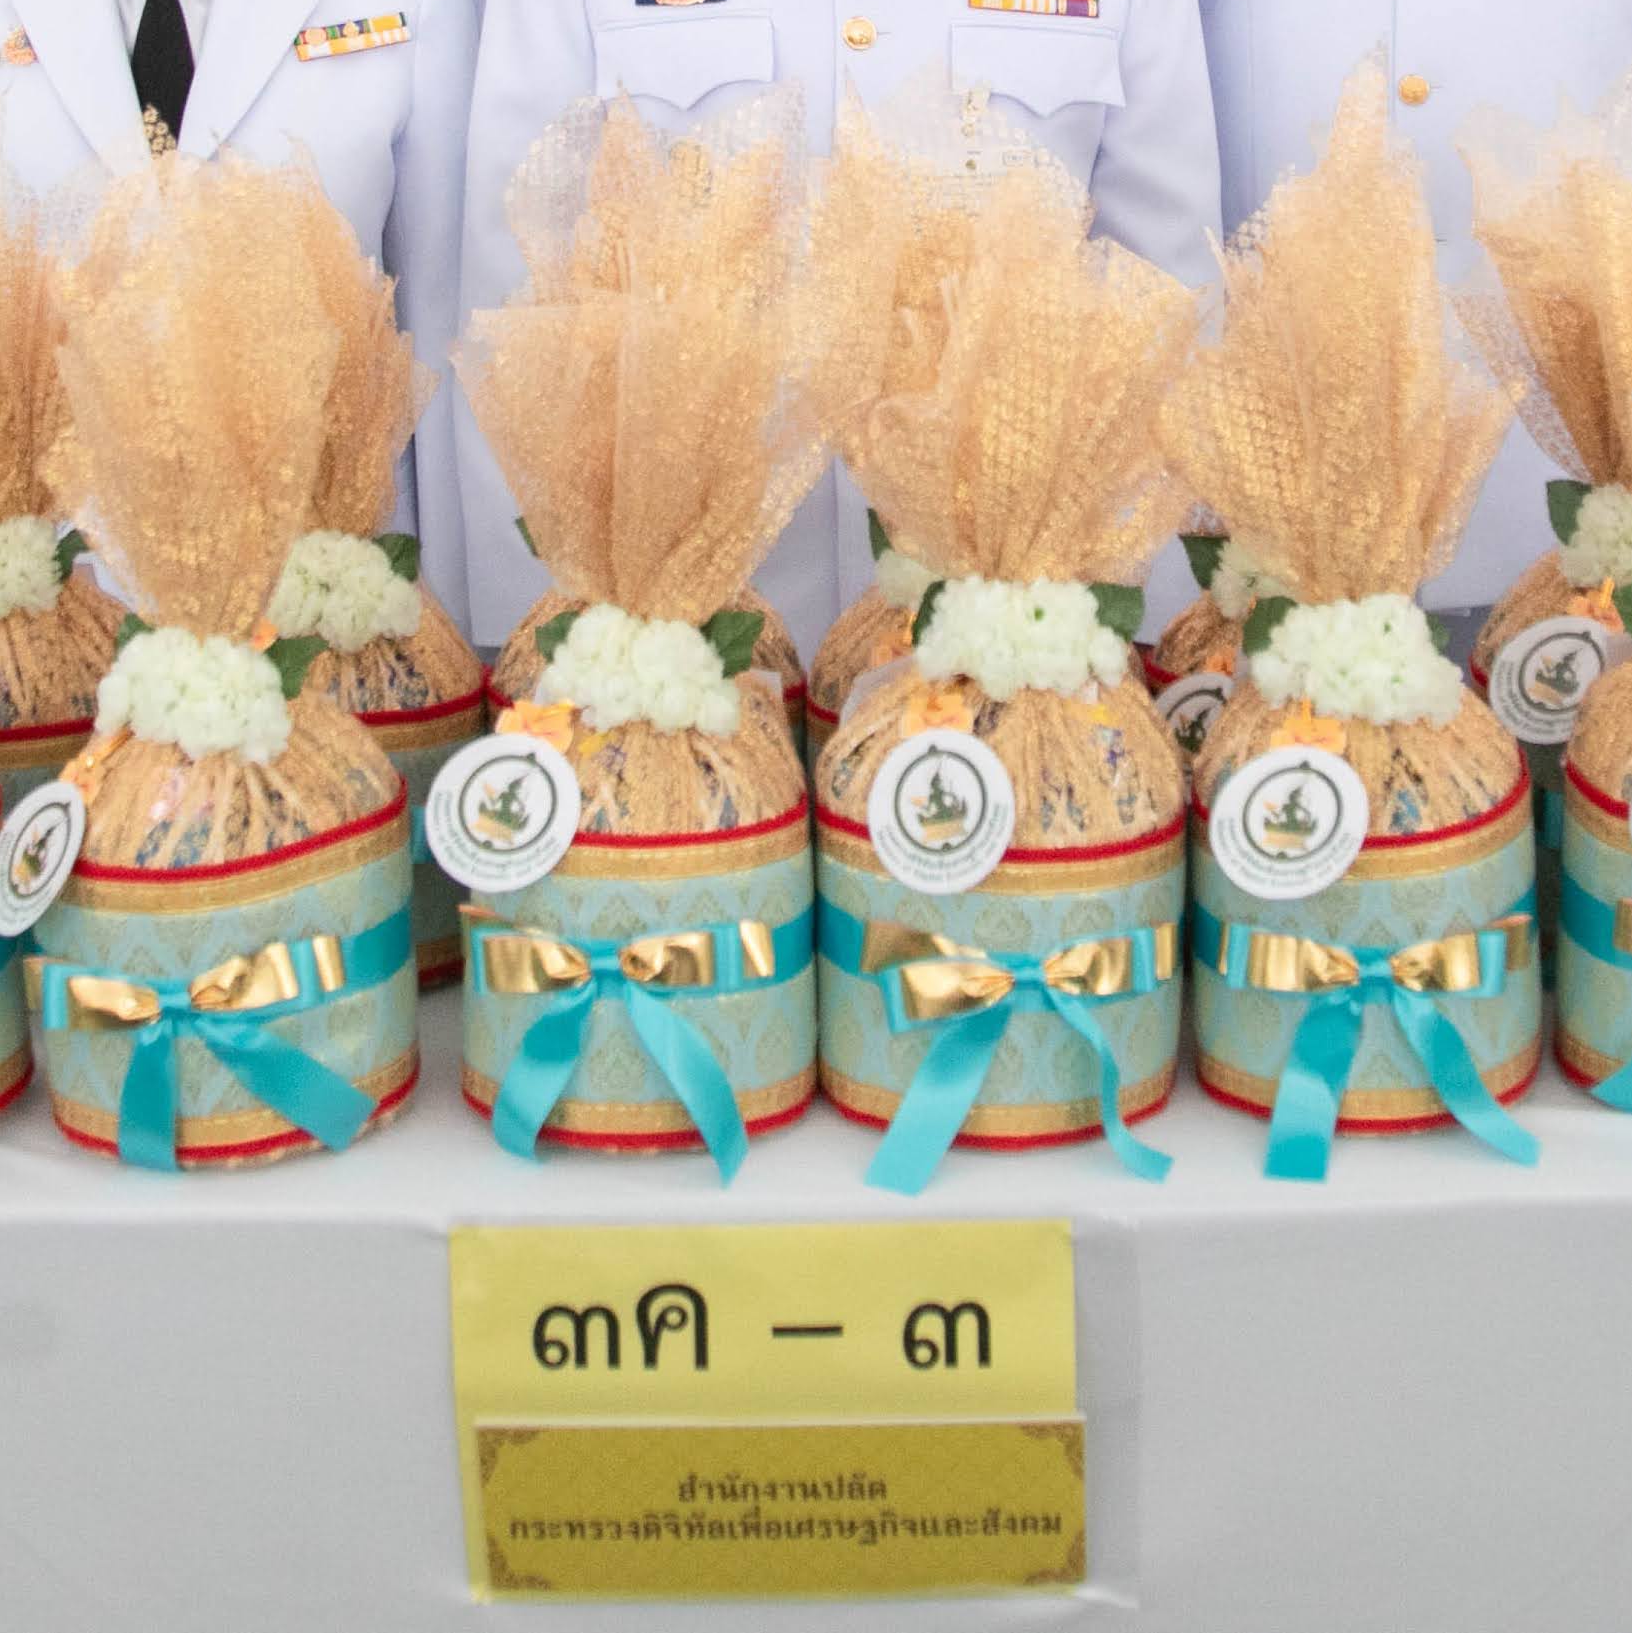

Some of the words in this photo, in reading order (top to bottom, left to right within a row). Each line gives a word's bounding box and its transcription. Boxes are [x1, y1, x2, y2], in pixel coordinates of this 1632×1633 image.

[532, 1283, 709, 1370] ๓ค
[902, 1300, 992, 1370] ๓
[677, 1469, 887, 1503] สำนักงานปลัด
